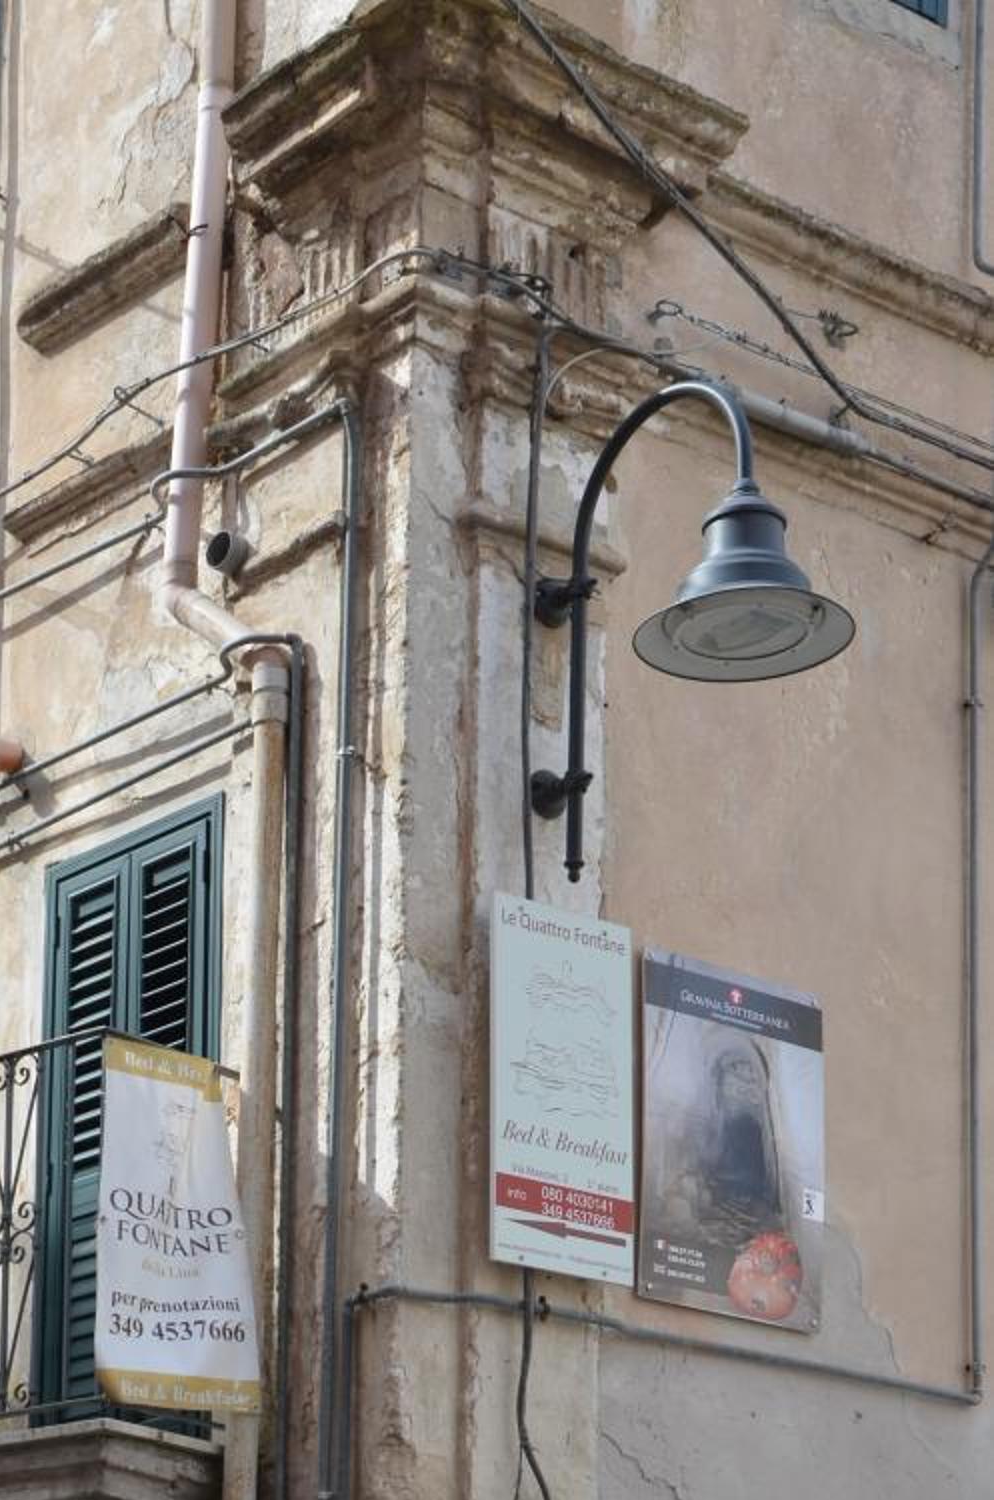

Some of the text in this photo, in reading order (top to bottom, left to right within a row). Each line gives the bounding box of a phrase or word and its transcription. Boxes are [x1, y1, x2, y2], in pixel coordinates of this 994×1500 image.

[501, 904, 625, 957] Le Quattro Fontane
[502, 1119, 628, 1168] Bed & Breakfast
[117, 1219, 231, 1257] FONTANE
[111, 1290, 241, 1314] per prenotazioni
[109, 1312, 246, 1343] 349 4537666
